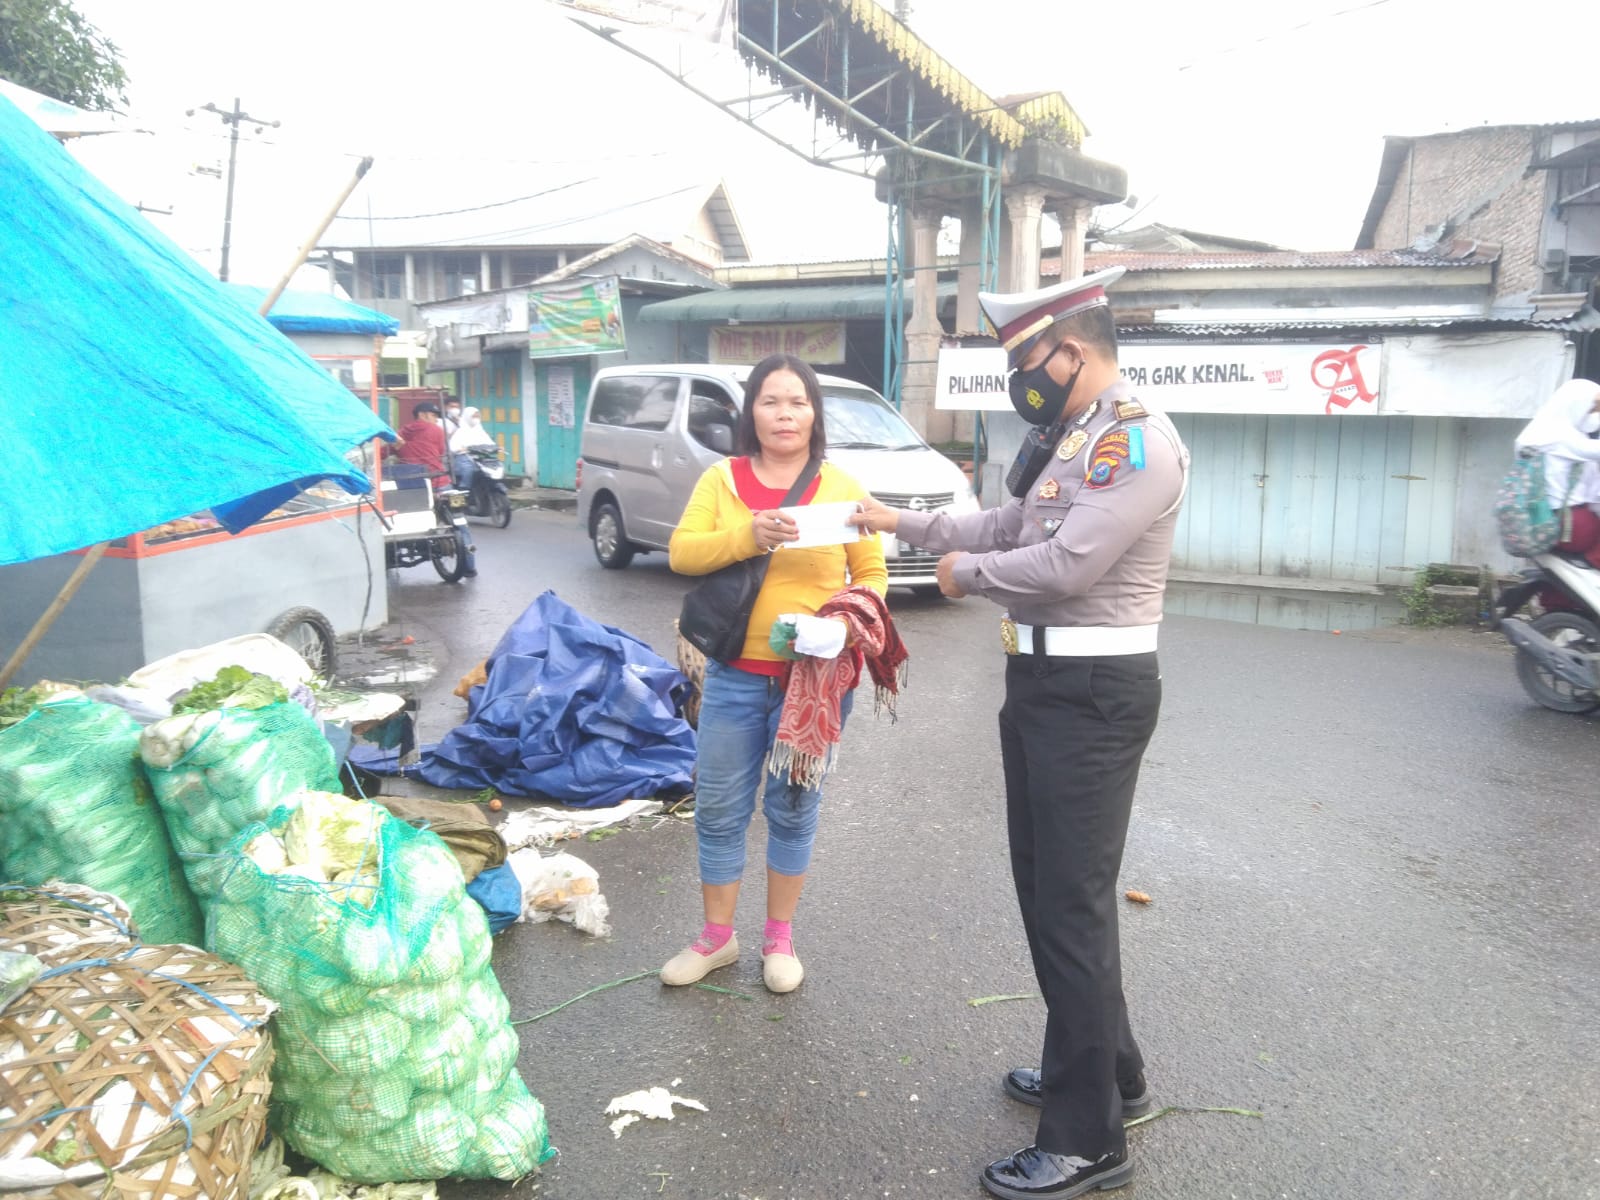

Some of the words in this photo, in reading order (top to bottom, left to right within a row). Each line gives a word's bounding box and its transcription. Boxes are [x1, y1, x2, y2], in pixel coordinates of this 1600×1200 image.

[949, 374, 1005, 394] PILIHAN
[1152, 365, 1187, 385] GAK
[1193, 363, 1255, 384] KENAL.
